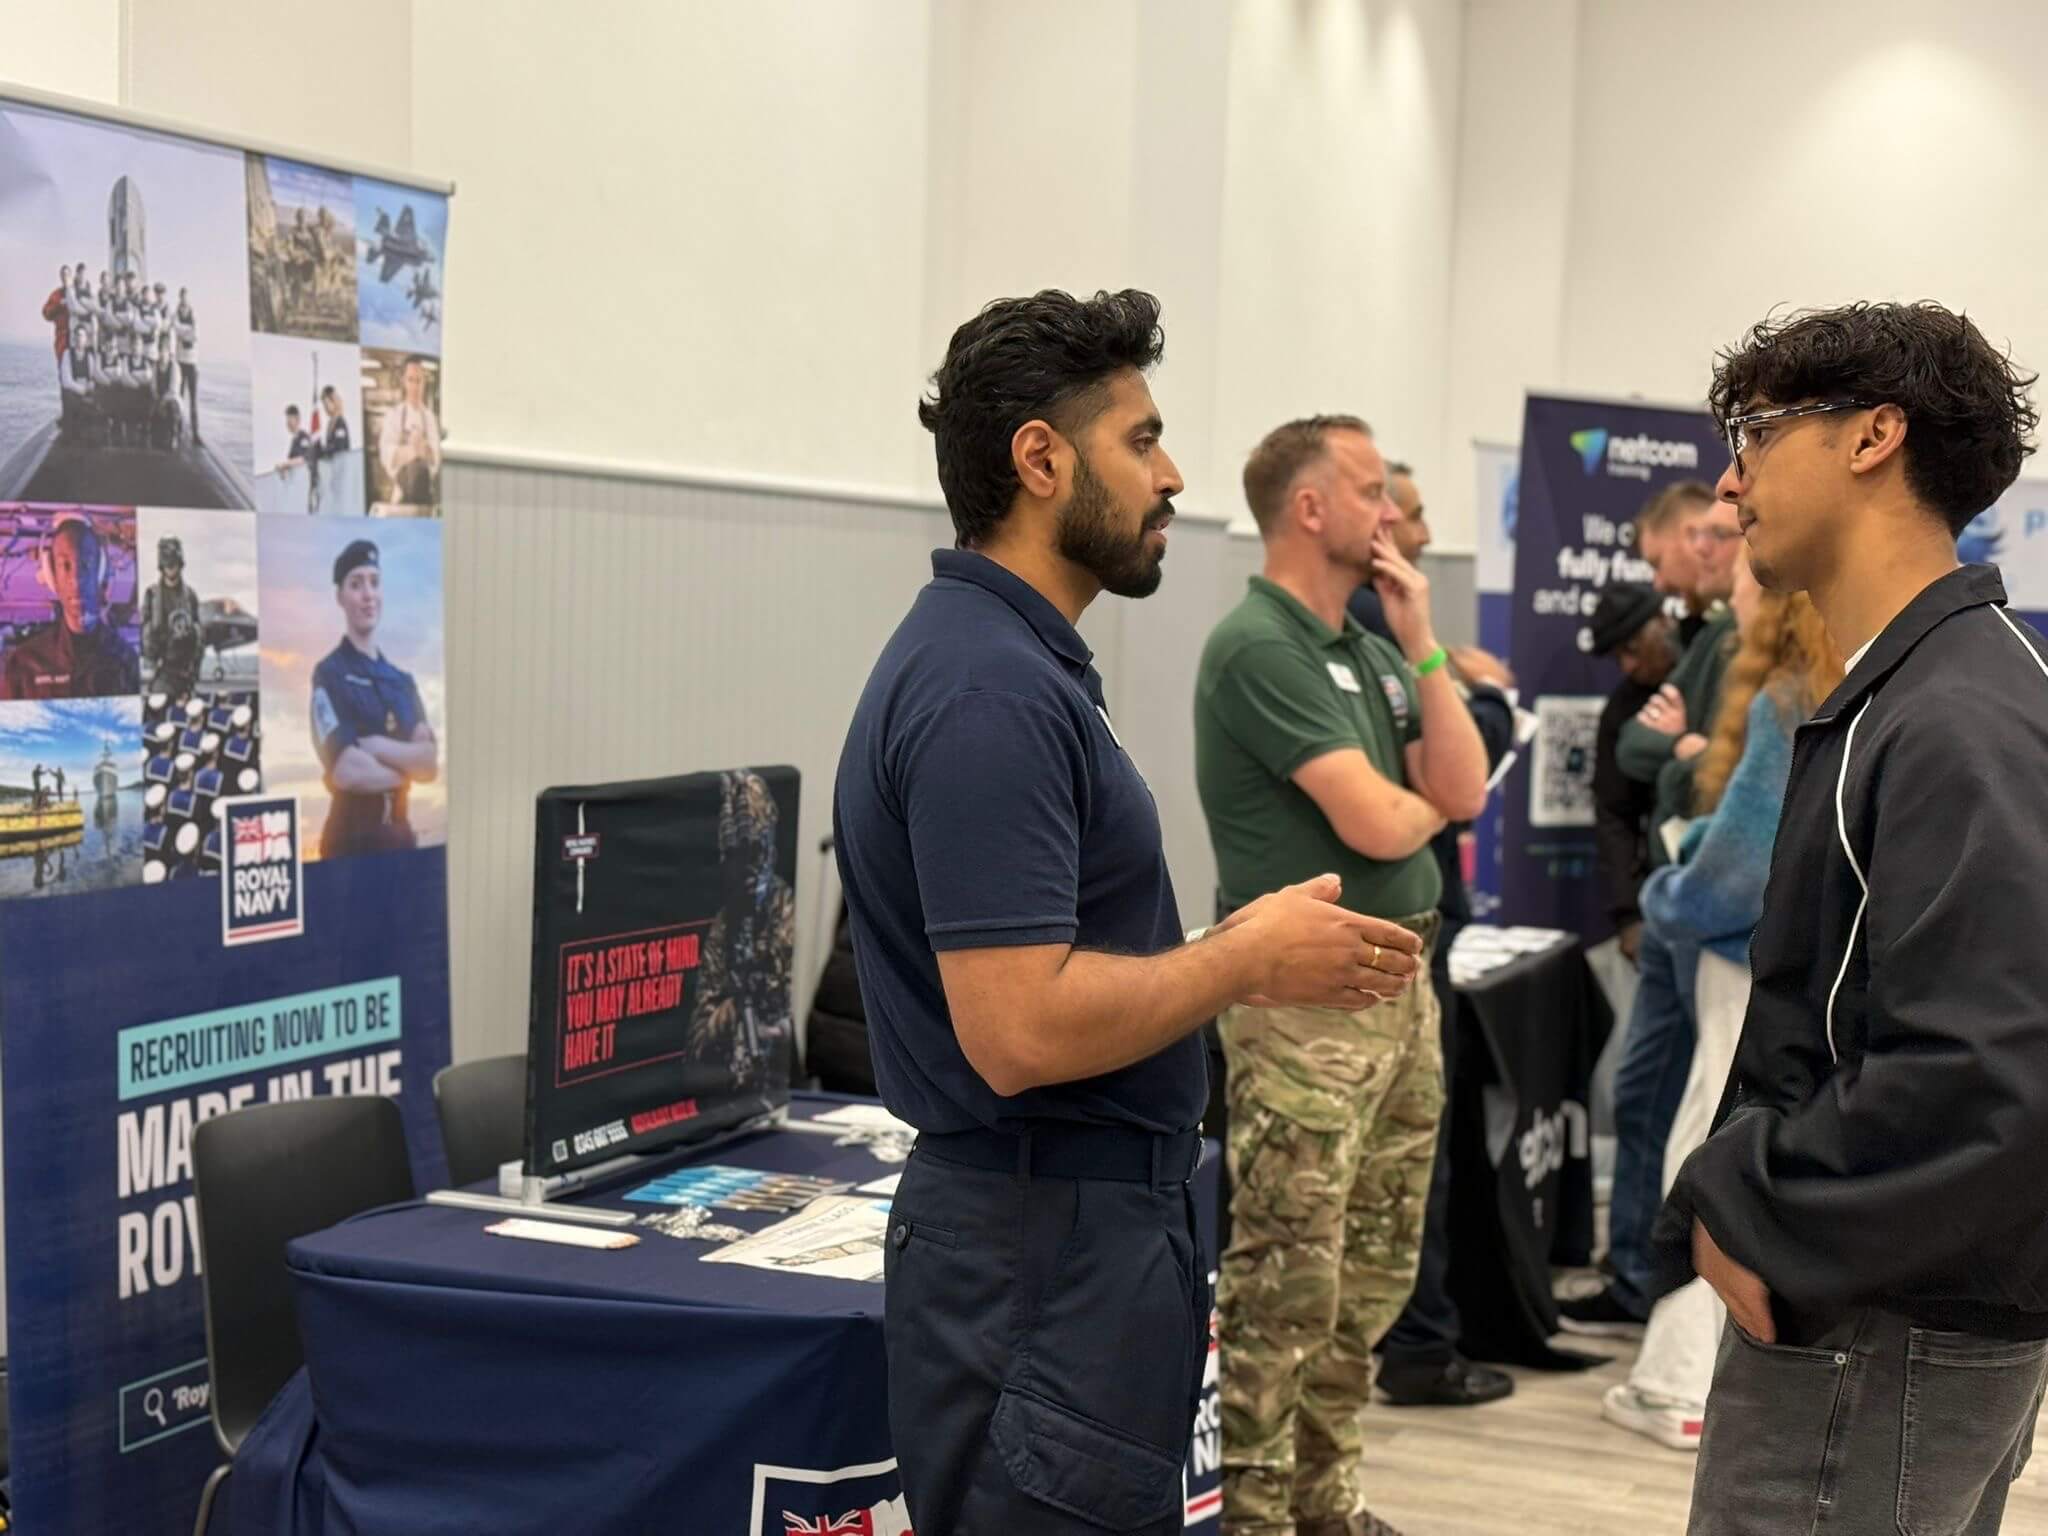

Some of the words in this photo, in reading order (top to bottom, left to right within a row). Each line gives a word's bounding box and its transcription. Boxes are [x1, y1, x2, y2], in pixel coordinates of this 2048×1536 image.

[1607, 432, 1698, 468] netcom
[1557, 546, 1609, 587] fully
[1533, 583, 1580, 616] and
[234, 864, 291, 892] ROYAL
[234, 887, 290, 918] NAVY
[567, 951, 595, 993] IT'S
[595, 949, 606, 985] A
[607, 942, 647, 983] STATE
[647, 940, 665, 975] OF
[567, 989, 595, 1031] YOU
[595, 984, 626, 1025] MAY
[626, 972, 684, 1017] ALREADY
[130, 1016, 265, 1084] RECRUITING
[273, 1004, 326, 1052] NOW
[331, 998, 358, 1038] TO
[365, 991, 391, 1031] BE
[564, 1027, 600, 1072] HAVE
[601, 1022, 616, 1060] IT
